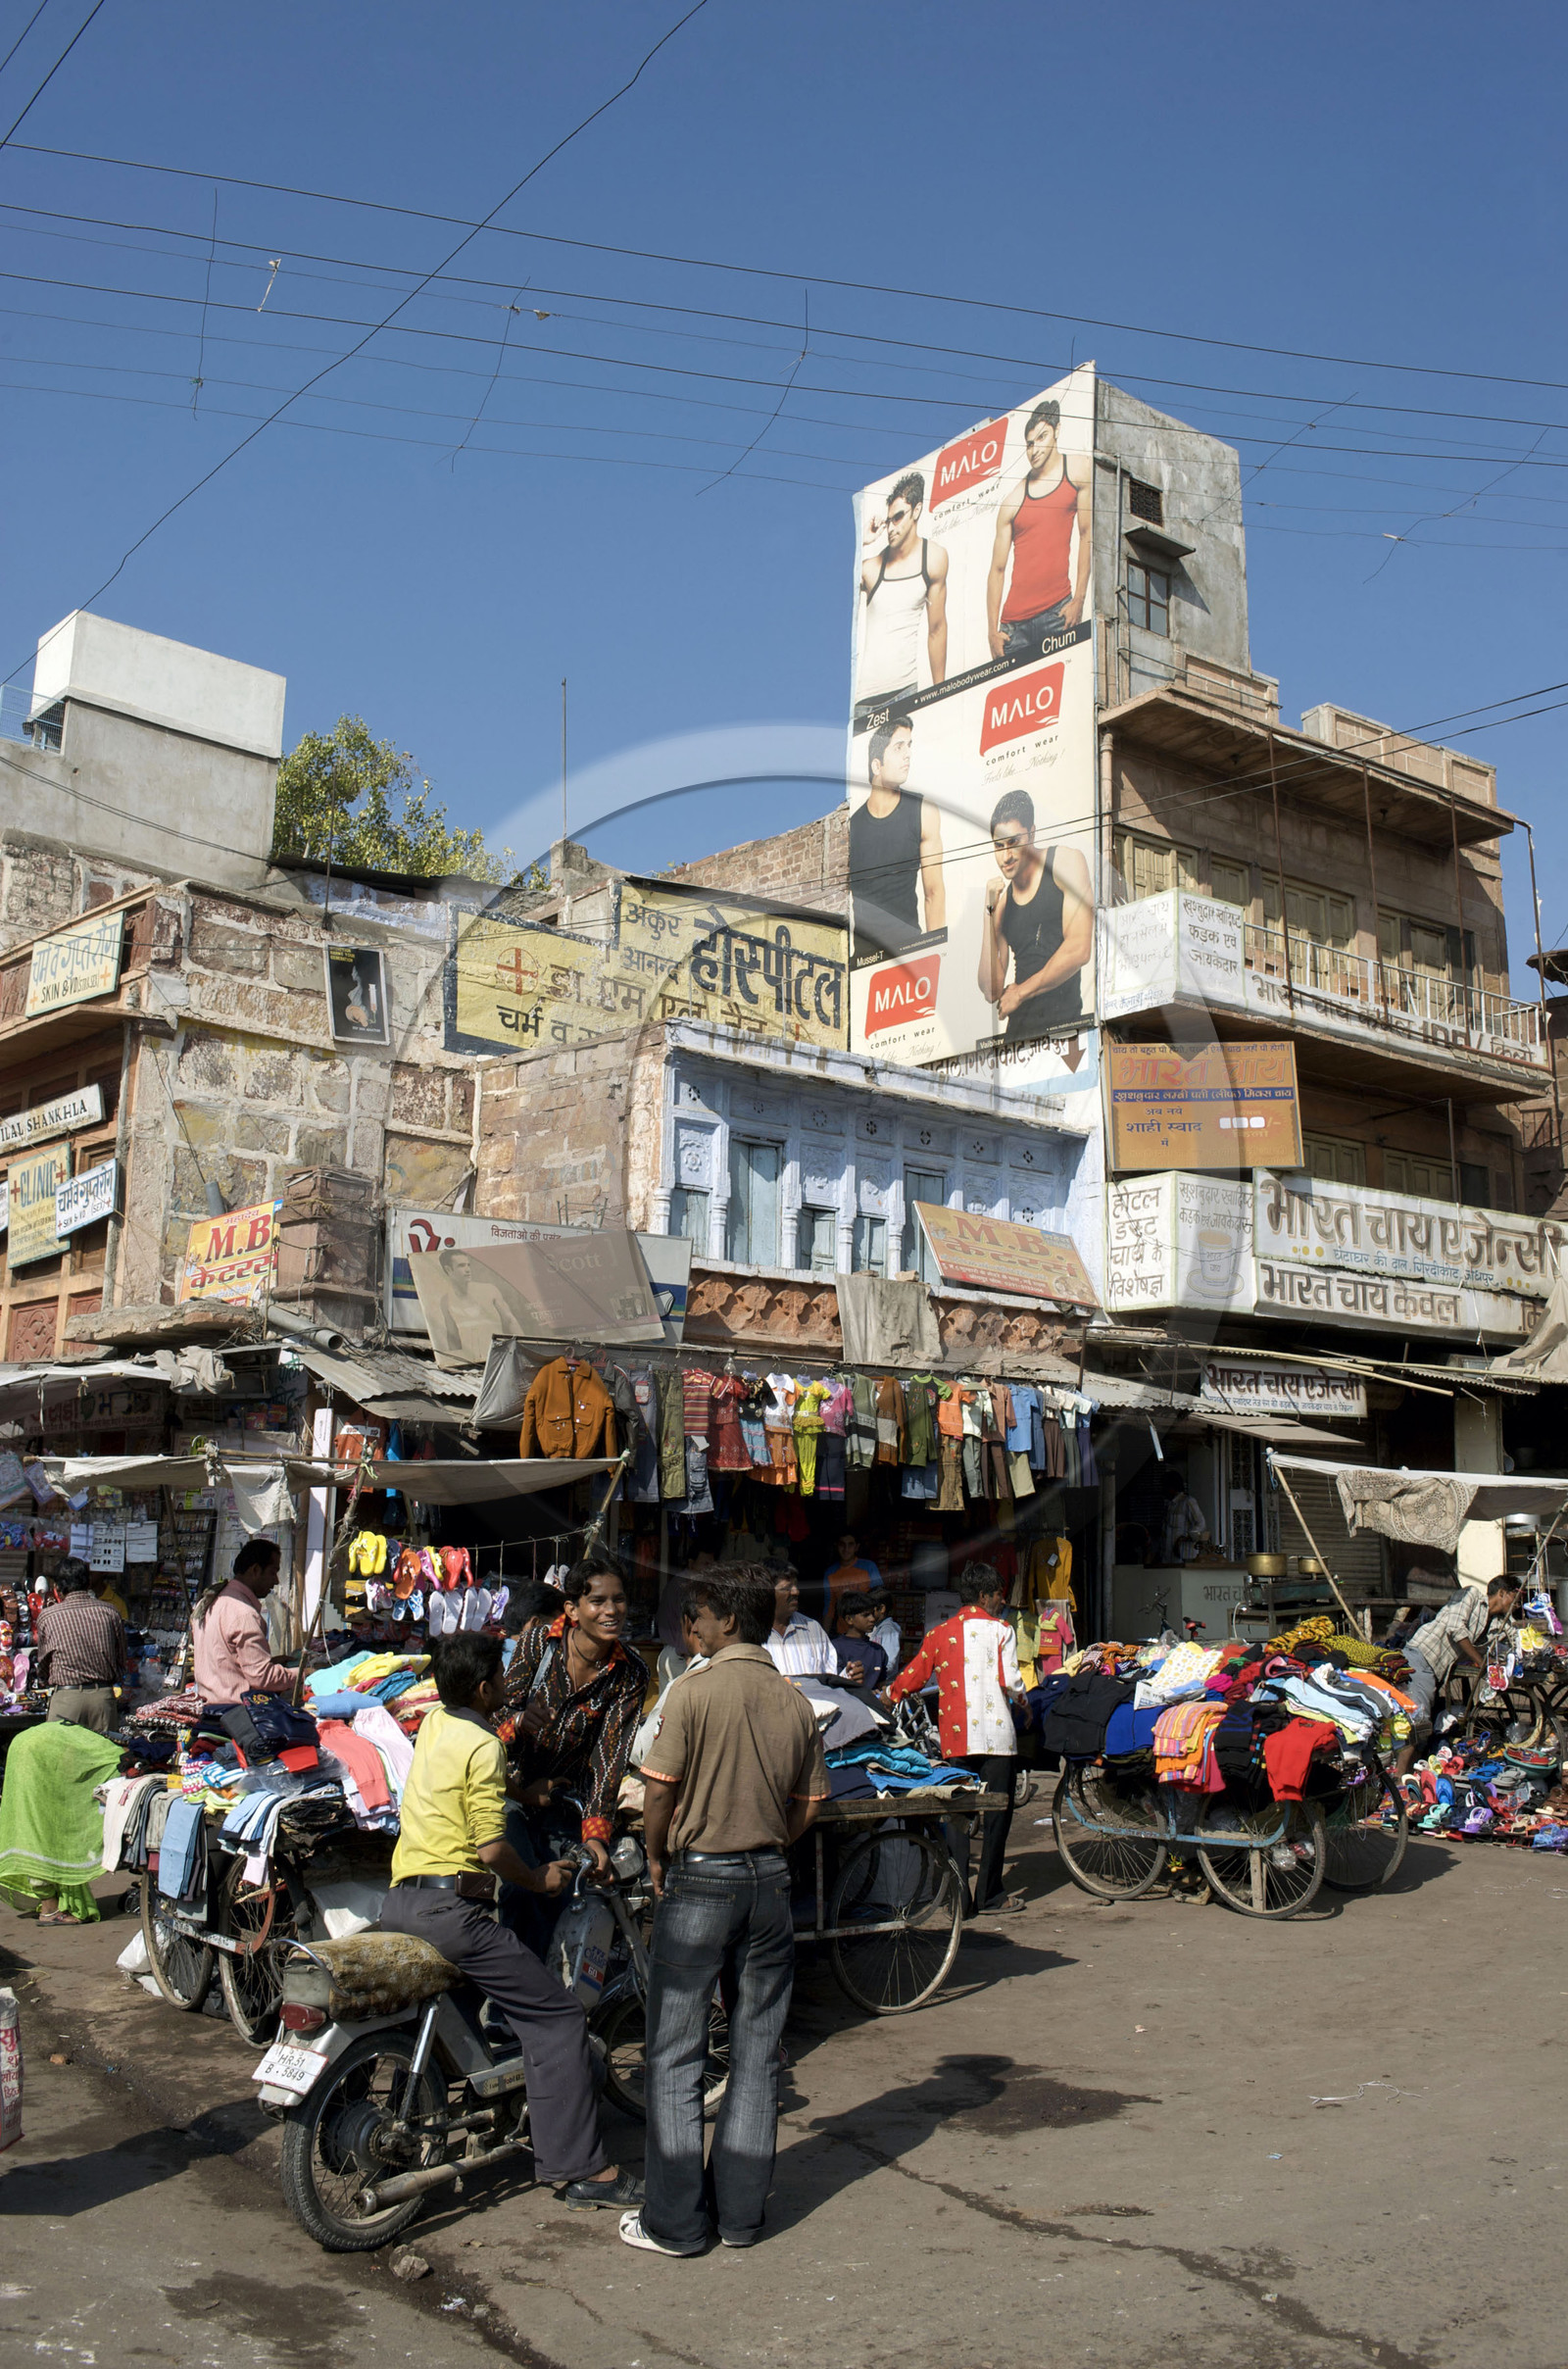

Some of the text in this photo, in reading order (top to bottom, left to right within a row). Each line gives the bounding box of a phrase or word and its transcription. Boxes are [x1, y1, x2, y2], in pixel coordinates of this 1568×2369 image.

[940, 440, 998, 487] MALO
[934, 482, 1001, 521] comfort wear
[1042, 629, 1077, 655] Chum
[919, 660, 1009, 703] www.malobodywear.com
[865, 708, 890, 730] Zest
[991, 686, 1054, 729] MALO
[986, 735, 1059, 766] comfort wear
[625, 902, 682, 941] अंकुर
[1189, 924, 1219, 947] कड़क
[32, 944, 52, 987] चर्म
[61, 932, 94, 980] गुप्त
[92, 919, 120, 966] रोग
[623, 947, 682, 985] आनन्द
[857, 951, 884, 967] Mussel-T
[41, 981, 60, 1004] SKIN
[62, 979, 70, 998] &
[874, 976, 931, 1013] MALO
[496, 1005, 544, 1038] चर्म
[870, 1026, 935, 1050] comfort wear
[980, 1037, 1004, 1050] Vaibhav
[1118, 1057, 1291, 1087] भारत चाय
[26, 1099, 87, 1133] SHANKHLA
[1126, 1118, 1202, 1132] शाही स्वाद
[20, 1160, 57, 1208] CLINIC
[58, 1181, 75, 1212] चर्म
[1112, 1186, 1162, 1219] होटल
[529, 1228, 541, 1241] की
[1259, 1178, 1568, 1279] भारत चाय एजेन्सी
[1152, 1238, 1163, 1263] के
[1374, 1253, 1388, 1268] की
[1109, 1270, 1165, 1298] विशेषज्ञ
[1259, 1262, 1333, 1308] भारत
[1337, 1277, 1390, 1316] चाय
[1394, 1279, 1462, 1324] केवल
[1206, 1363, 1362, 1401] भारत चाय एजेन्सी
[1203, 1585, 1231, 1601] भारत
[588, 1965, 598, 1978] 60
[278, 2053, 306, 2068] HR.51
